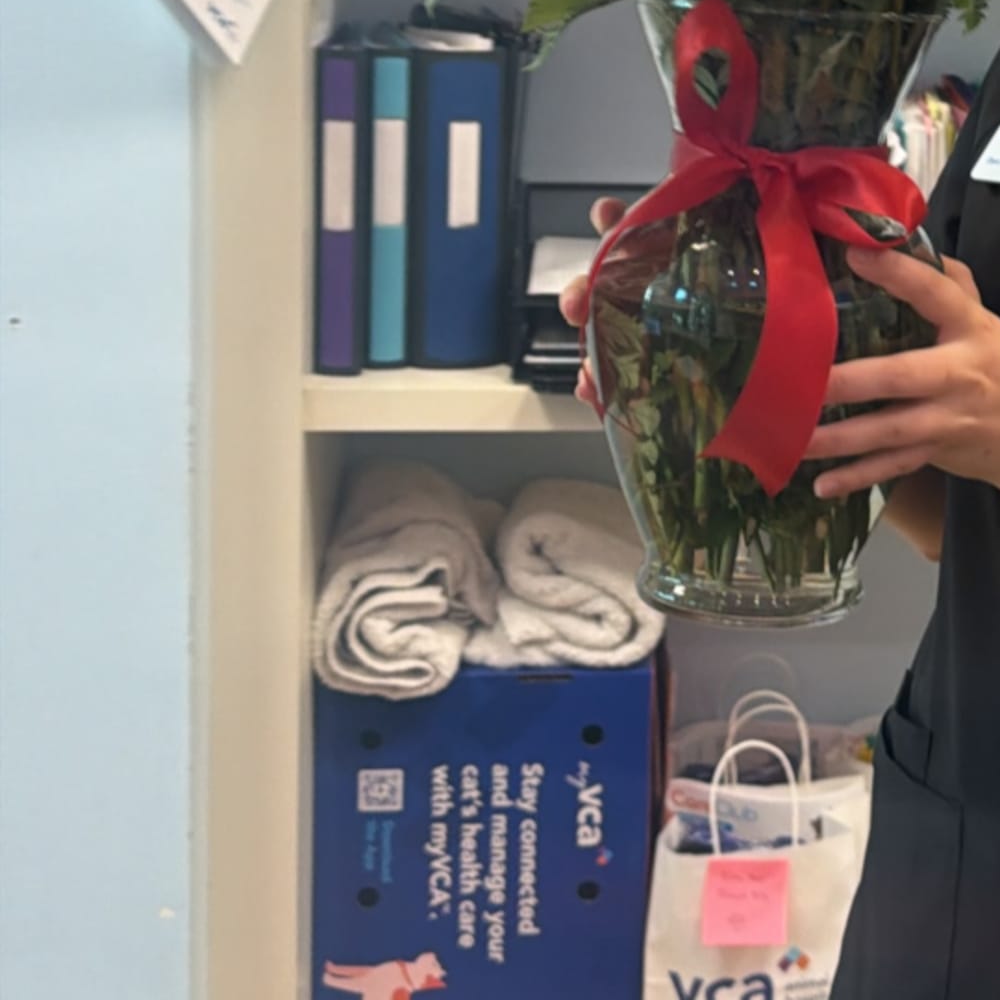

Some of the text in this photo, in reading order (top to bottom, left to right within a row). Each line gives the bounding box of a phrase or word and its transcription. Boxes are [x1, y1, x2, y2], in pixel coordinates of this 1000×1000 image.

[430, 764, 455, 817] with
[457, 764, 483, 948] cat's health care
[484, 764, 513, 963] and manage your
[517, 762, 545, 936] Stay connected
